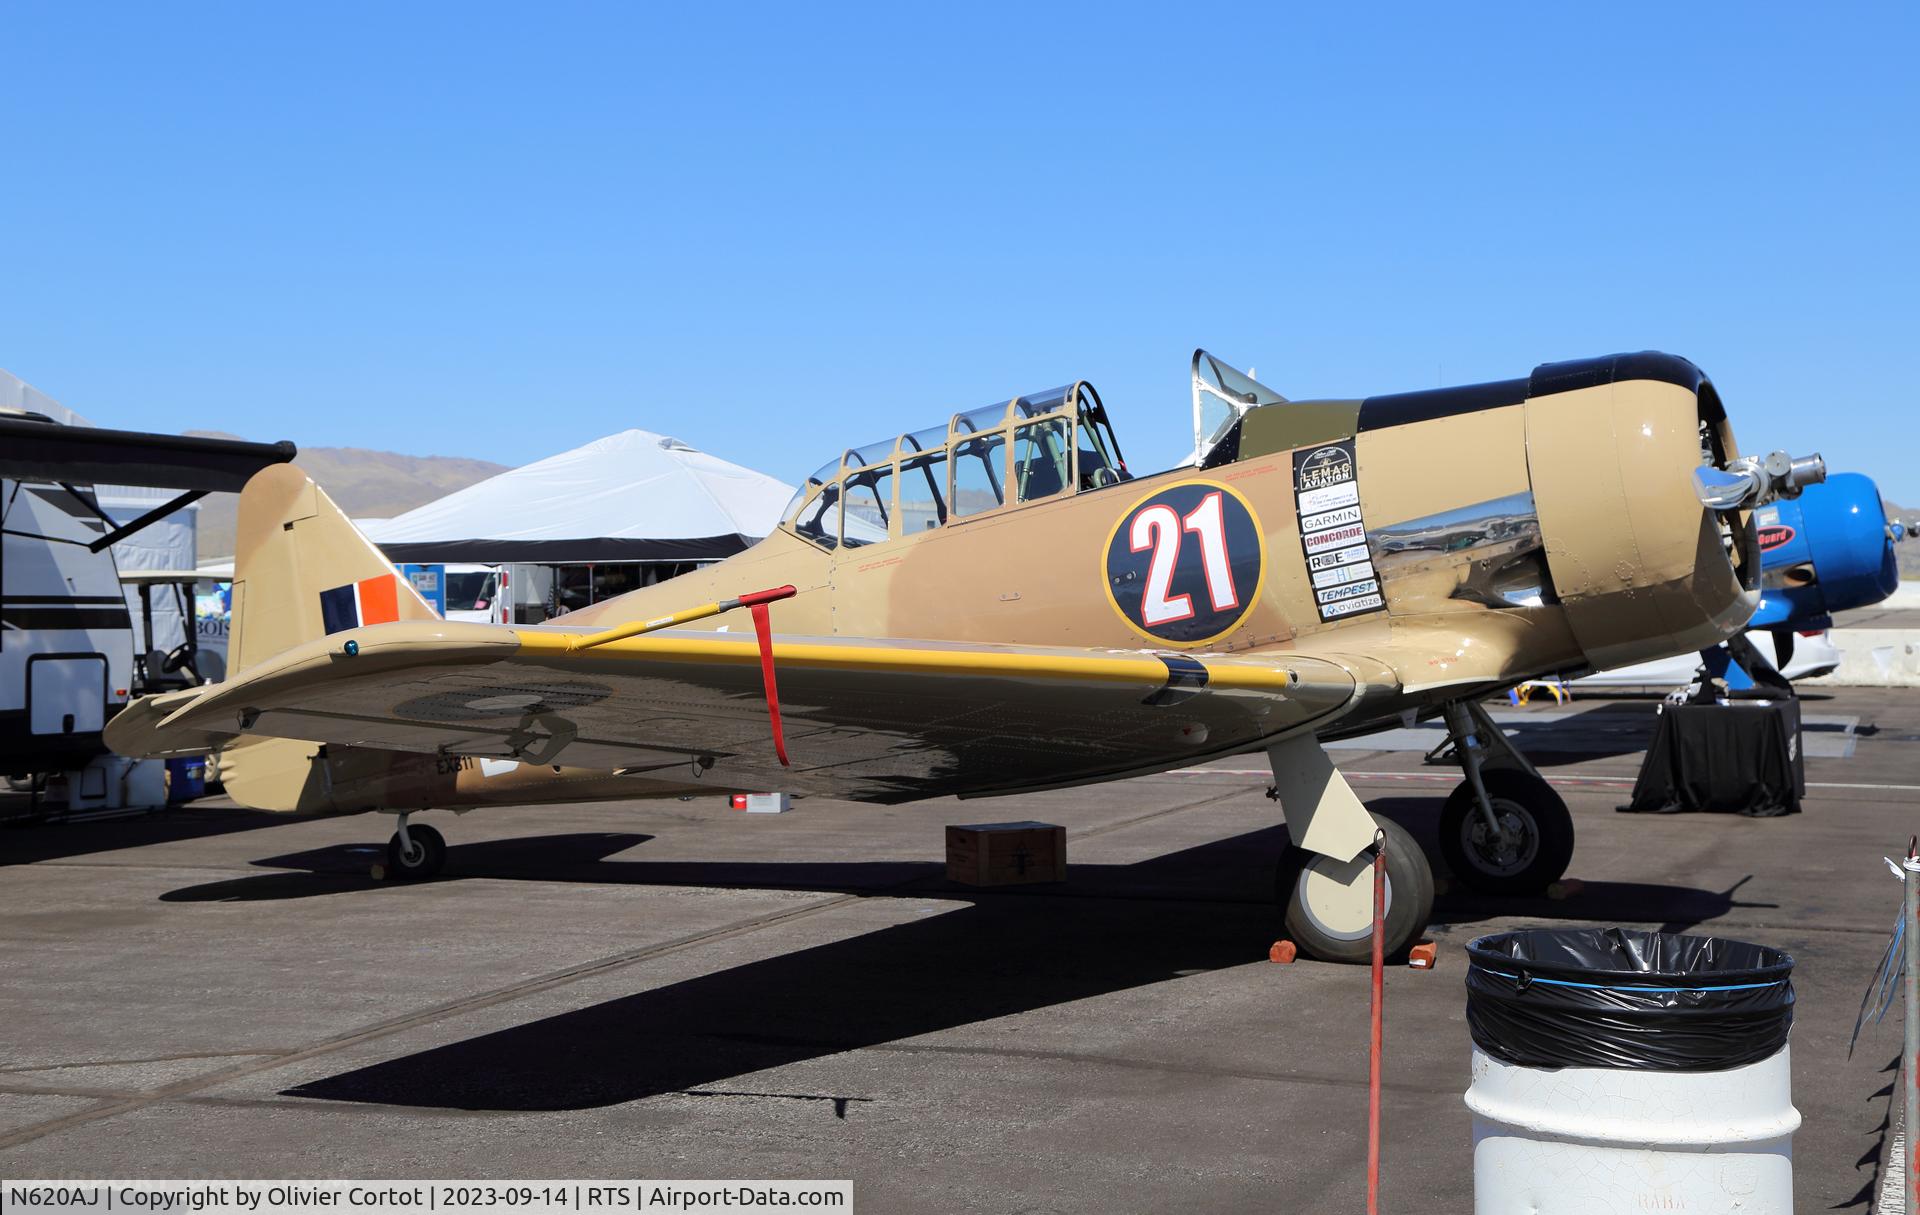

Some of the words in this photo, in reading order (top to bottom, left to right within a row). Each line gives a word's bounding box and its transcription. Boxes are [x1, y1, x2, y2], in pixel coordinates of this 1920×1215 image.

[1305, 472, 1349, 488] AVIATION
[1304, 510, 1358, 529] GARMIN
[1306, 527, 1363, 547] CONCORDE
[1129, 491, 1239, 627] 21
[1321, 581, 1374, 600] TEMPEST
[1339, 597, 1380, 611] aviatize
